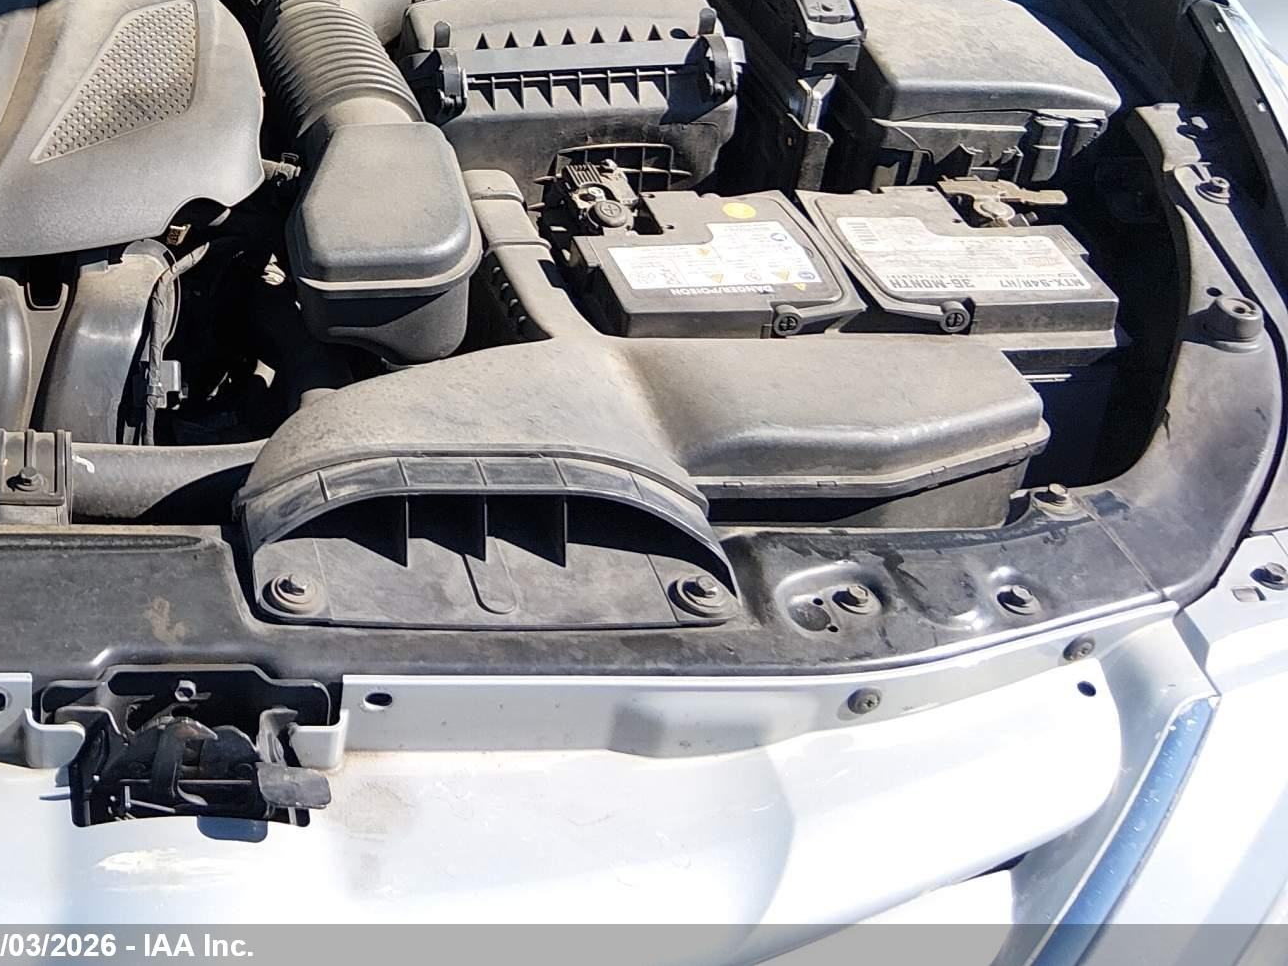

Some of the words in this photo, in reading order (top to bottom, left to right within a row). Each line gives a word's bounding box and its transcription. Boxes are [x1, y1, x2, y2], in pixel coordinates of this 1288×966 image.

[890, 278, 976, 289] 36-MONTH
[999, 278, 1085, 289] MTX-94R/H7
[670, 284, 775, 297] DANGER/POISON
